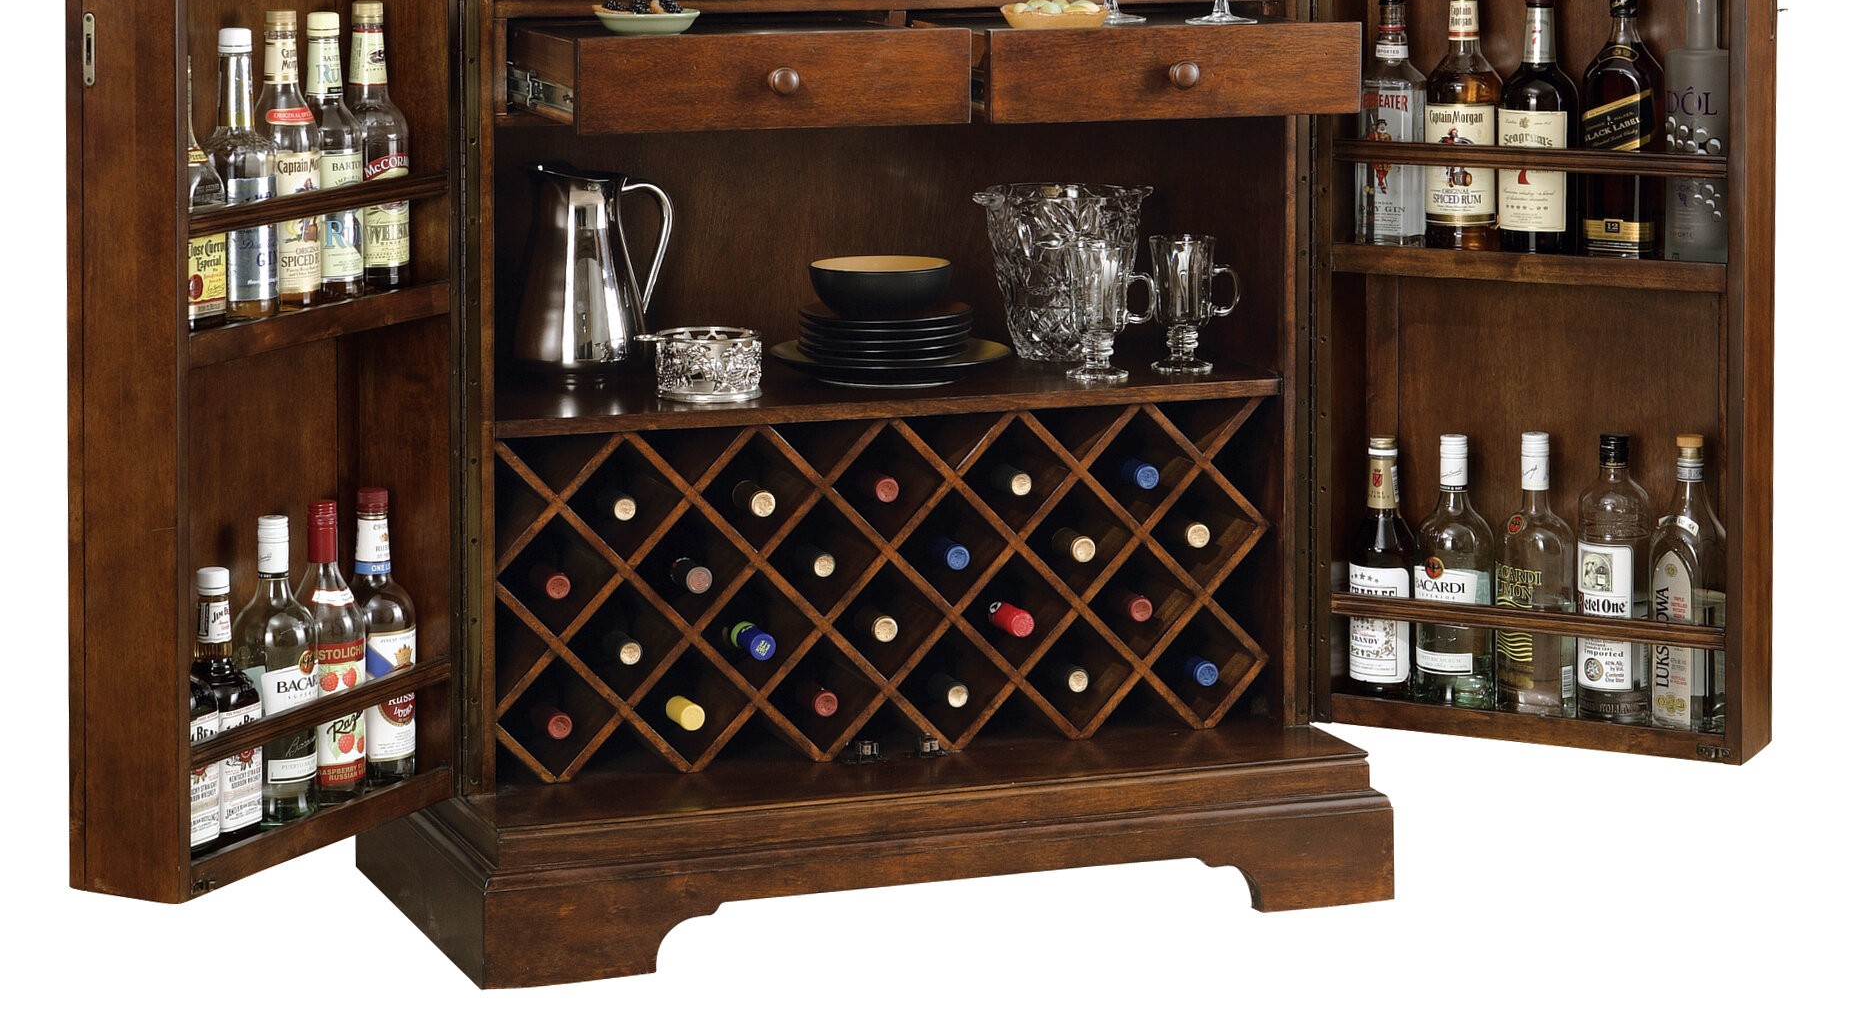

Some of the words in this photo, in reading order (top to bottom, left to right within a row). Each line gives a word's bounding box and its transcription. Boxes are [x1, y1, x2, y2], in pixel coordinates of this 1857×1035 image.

[1429, 109, 1454, 125] Captain
[1452, 111, 1484, 125] Morgan
[277, 158, 308, 176] Captain
[1432, 193, 1460, 205] SPICED
[1461, 193, 1482, 205] RUM
[1387, 205, 1406, 214] GIN
[196, 255, 222, 273] Especial
[281, 252, 314, 268] SPICED
[371, 564, 384, 572] ONE
[1601, 598, 1626, 614] One
[211, 610, 223, 624] JIM
[1584, 648, 1624, 658] Imported
